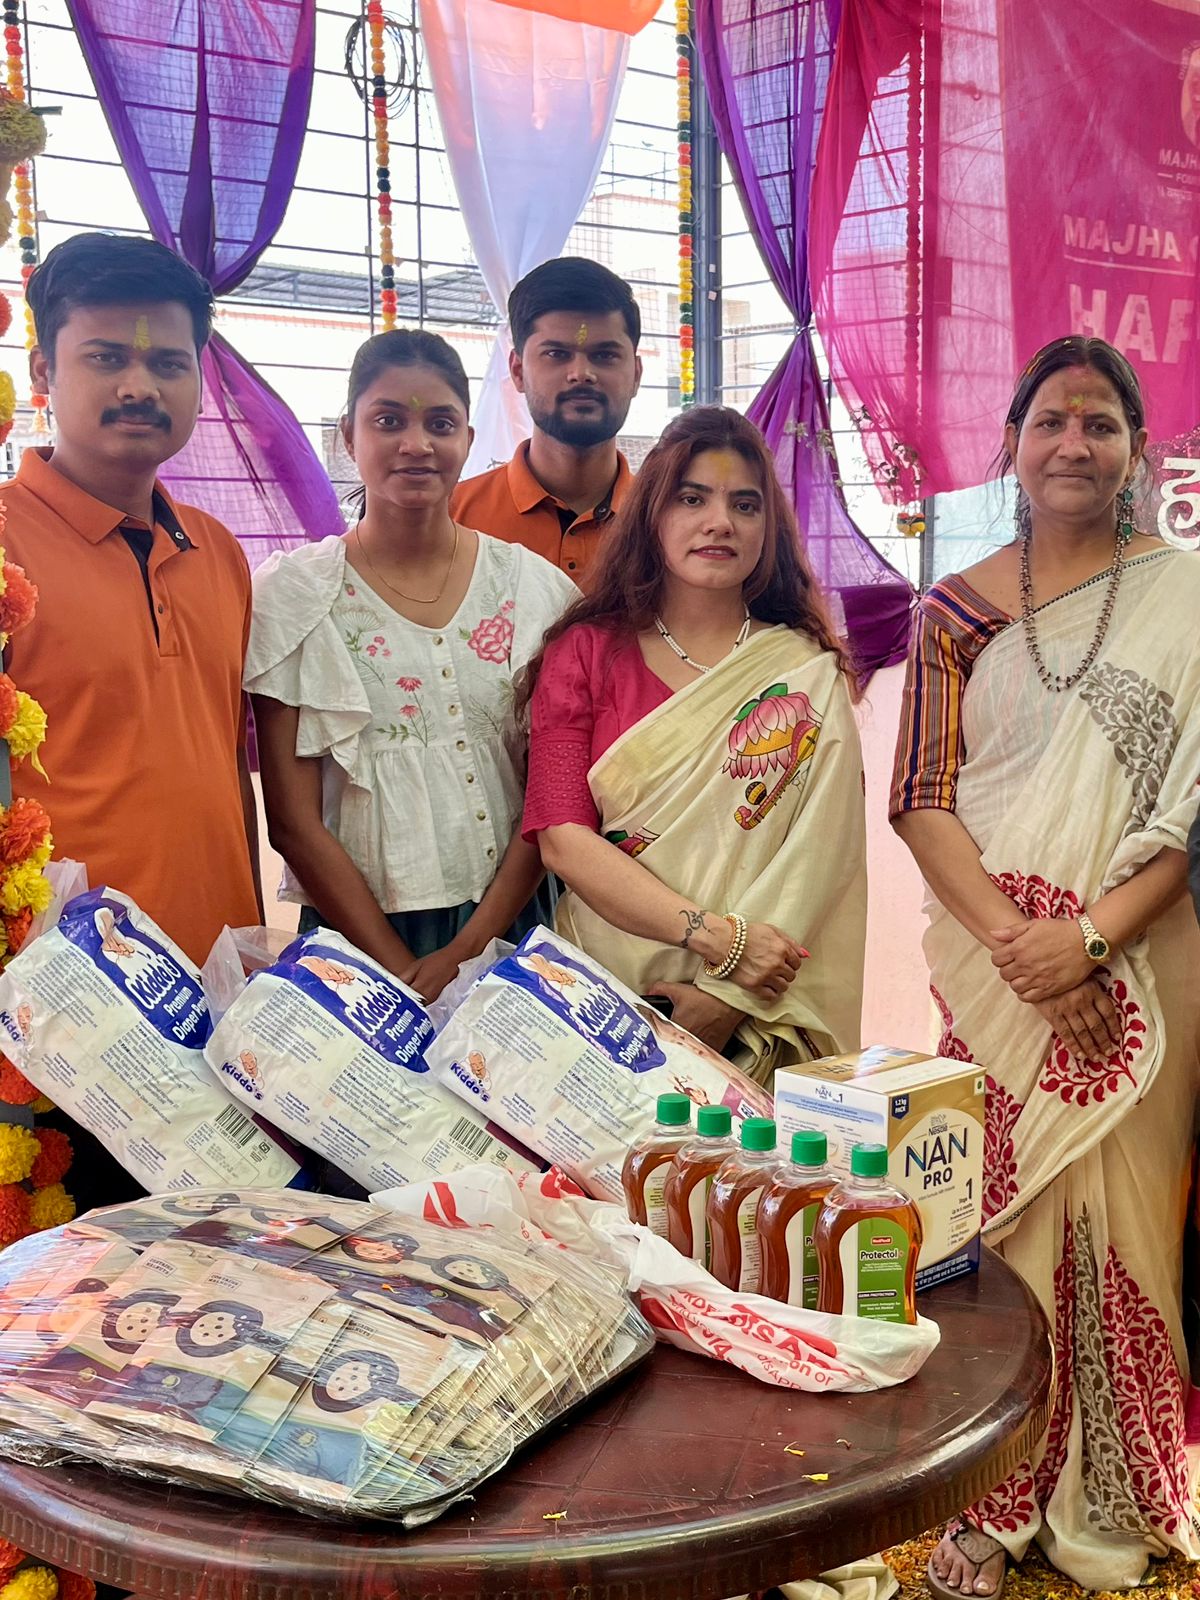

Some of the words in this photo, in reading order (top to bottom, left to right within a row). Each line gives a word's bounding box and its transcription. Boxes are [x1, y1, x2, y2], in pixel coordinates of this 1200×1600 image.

[1064, 214, 1181, 262] MAJHA
[124, 954, 180, 1008] Kiddo's
[162, 985, 193, 1016] Premium
[344, 981, 400, 1033] Kiddo's
[569, 983, 619, 1034] Kiddo's
[171, 1009, 199, 1040] Diaper
[384, 1008, 415, 1041] Premium
[394, 1032, 422, 1063] Diaper
[413, 1017, 432, 1039] Pants
[606, 1013, 633, 1042] Premium
[617, 1036, 642, 1064] Diaper
[221, 1061, 263, 1100] Kiddo's
[450, 1062, 490, 1103] Kiddo's
[905, 1127, 968, 1178] NAN
[923, 1167, 953, 1190] PRO
[965, 1178, 973, 1200] 1
[860, 1248, 898, 1260] Protectol
